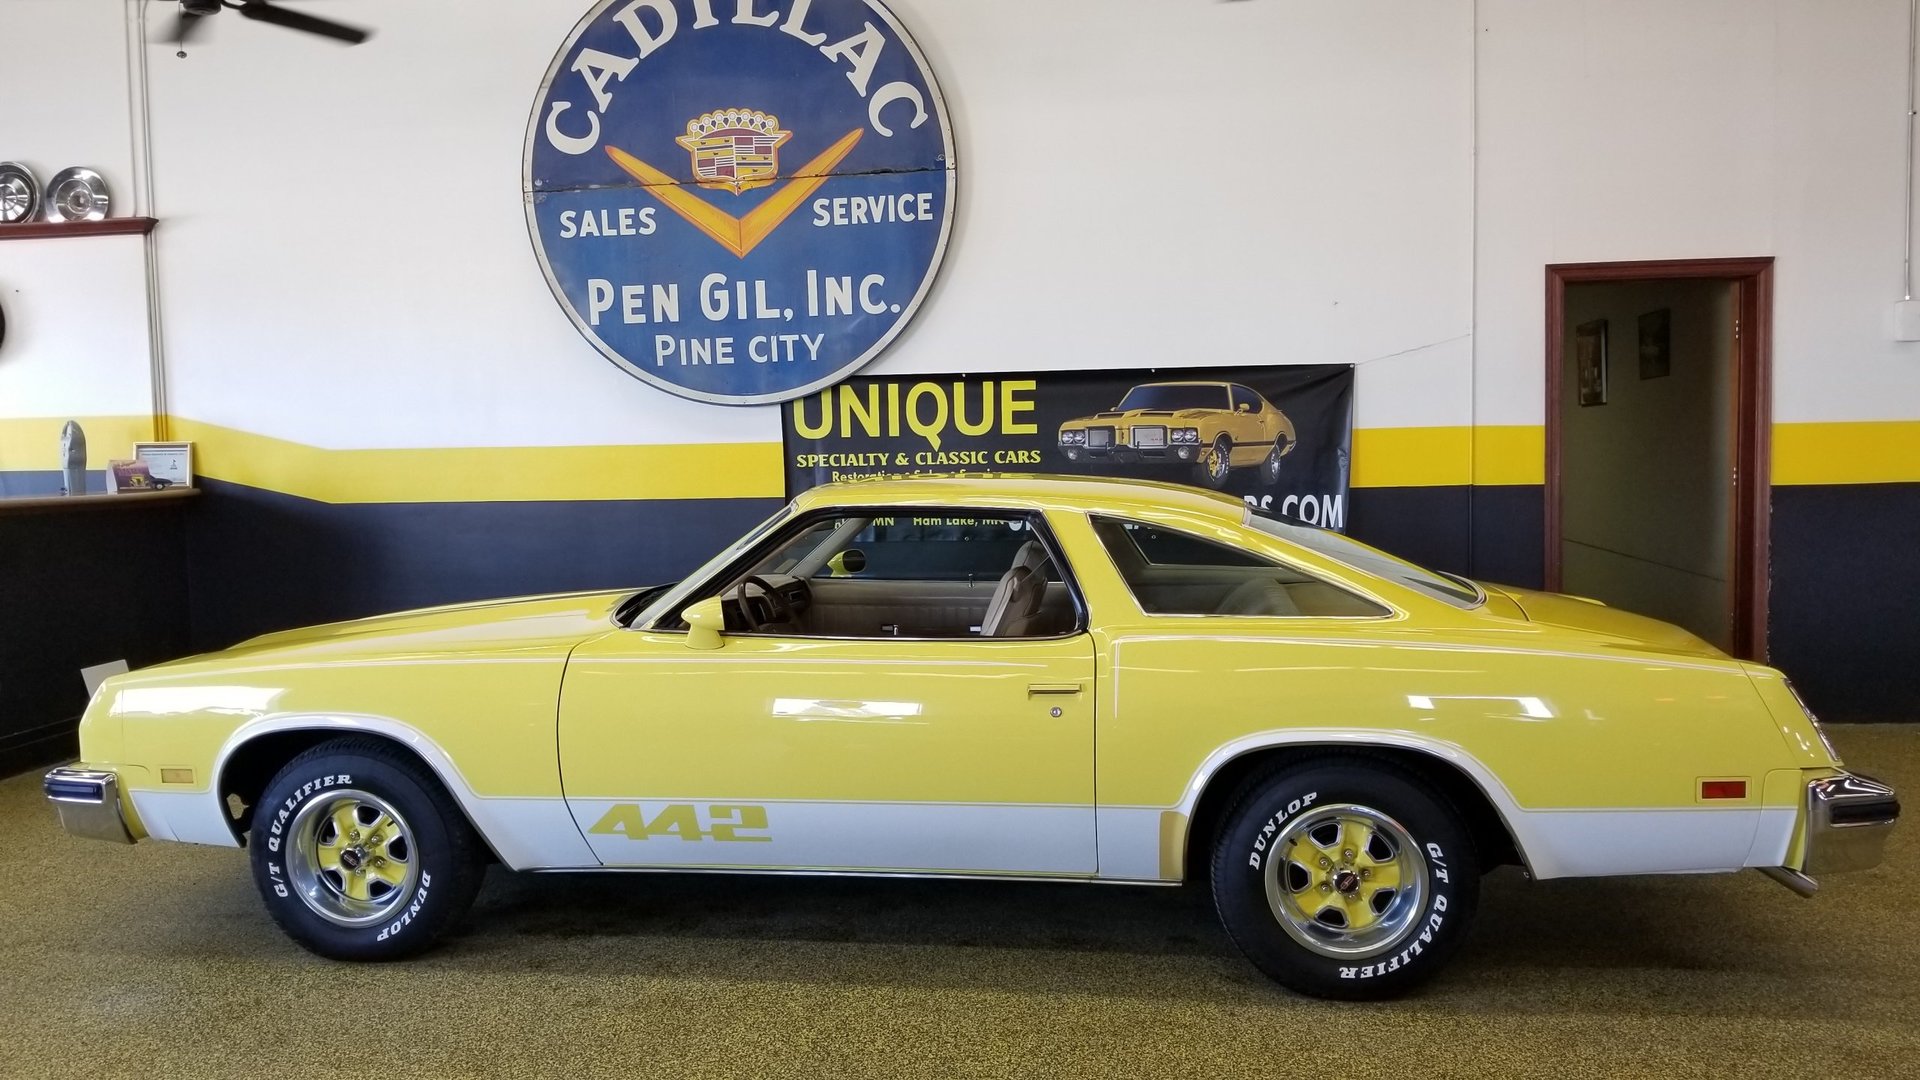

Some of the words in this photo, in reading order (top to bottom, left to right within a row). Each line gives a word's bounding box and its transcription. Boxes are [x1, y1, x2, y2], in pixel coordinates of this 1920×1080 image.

[546, 0, 928, 154] CADILLAC
[559, 208, 657, 238] SALES
[812, 193, 934, 227] SERVICE
[587, 278, 679, 325] PEN
[700, 273, 793, 321] GIL,
[807, 269, 901, 317] INC.
[655, 335, 735, 366] PINE
[748, 333, 825, 363] CITY
[793, 380, 1038, 452] UNIQUE
[796, 452, 889, 468] SPECIALTY
[895, 452, 909, 466] &
[915, 450, 988, 465] CLASSIC
[994, 449, 1041, 464] CARS
[913, 517, 942, 526] Ham
[946, 517, 978, 527] Lake,
[268, 774, 353, 852] QUALIFIER
[1249, 791, 1318, 870] DUNLOP
[268, 862, 289, 898] G/T
[1425, 842, 1449, 884] G/T
[376, 869, 432, 942] DUNLOP
[1338, 894, 1448, 979] QUALIFIER
